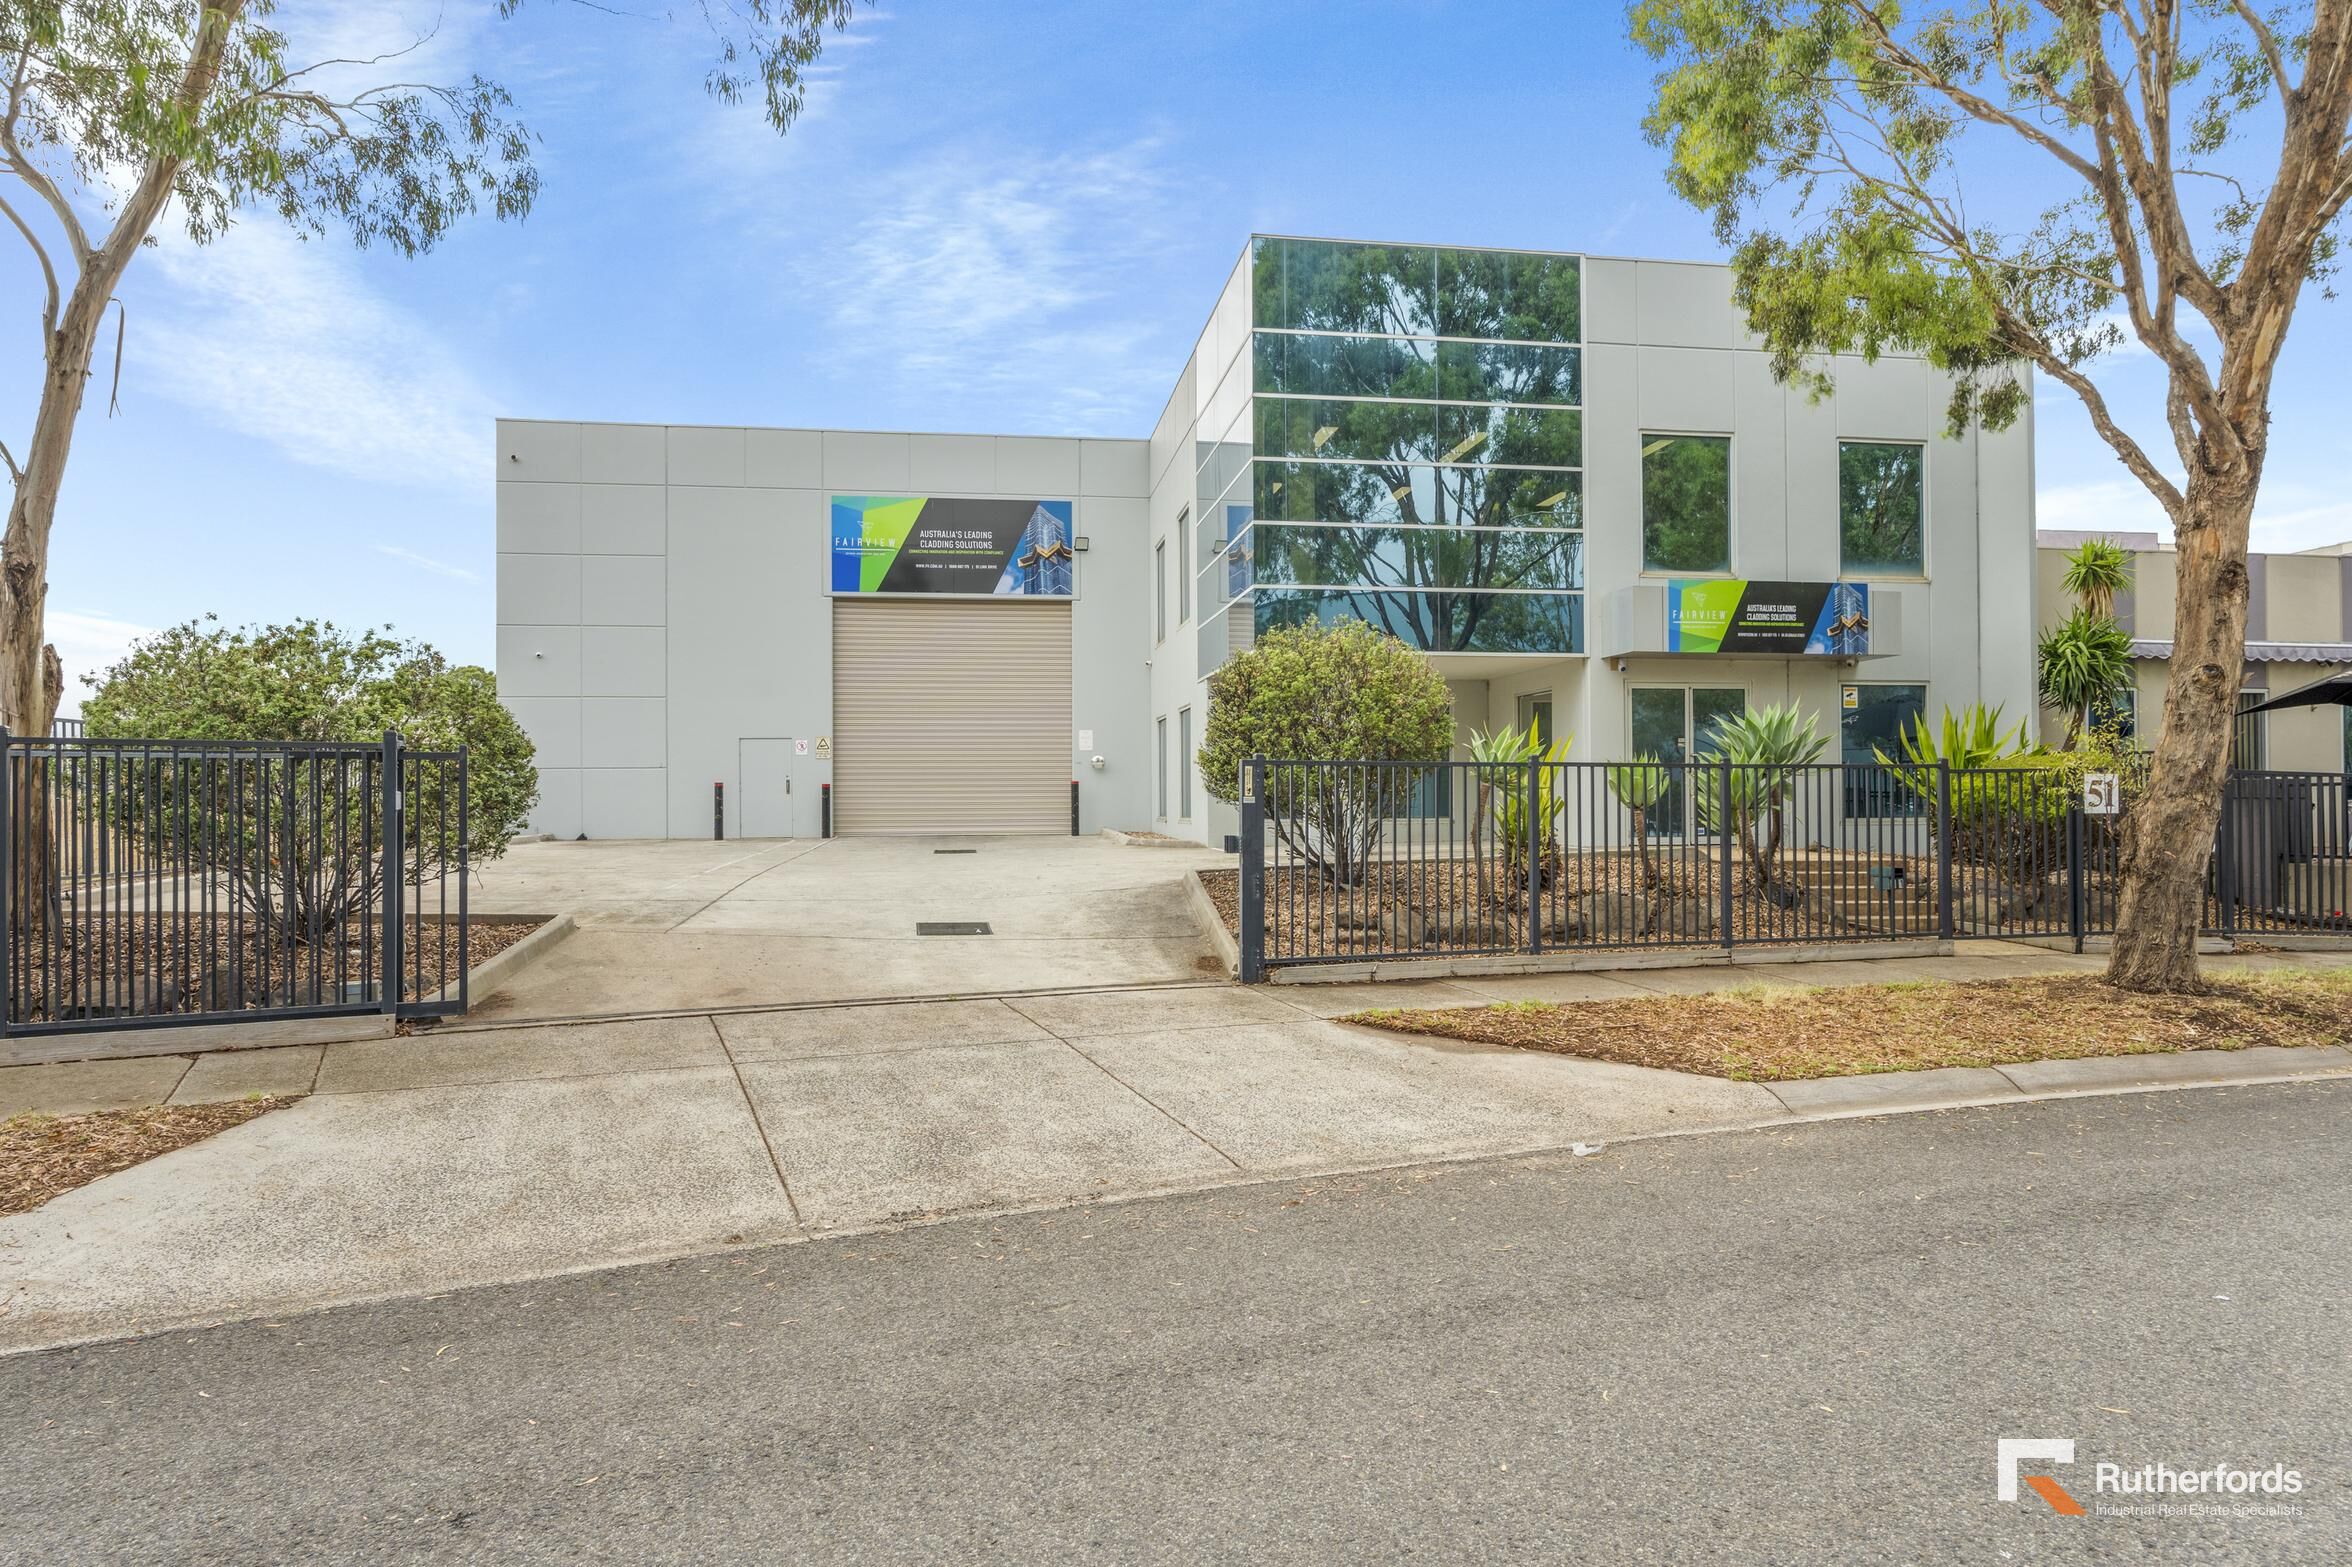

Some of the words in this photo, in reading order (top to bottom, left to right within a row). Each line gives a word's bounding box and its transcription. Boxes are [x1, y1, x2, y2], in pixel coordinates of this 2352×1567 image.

[920, 530, 962, 539] AUSTRALIA'S
[964, 531, 992, 540] LEADING
[835, 537, 895, 547] FAIRVIEW
[920, 540, 953, 548] CLADDING
[955, 541, 992, 549] SOLUTIONS
[1747, 604, 1776, 612] AUSTRALIA'S
[1672, 609, 1726, 620] FAIRVIEW
[1770, 613, 1796, 621] SOLUTIONS
[2088, 780, 2114, 807] 51
